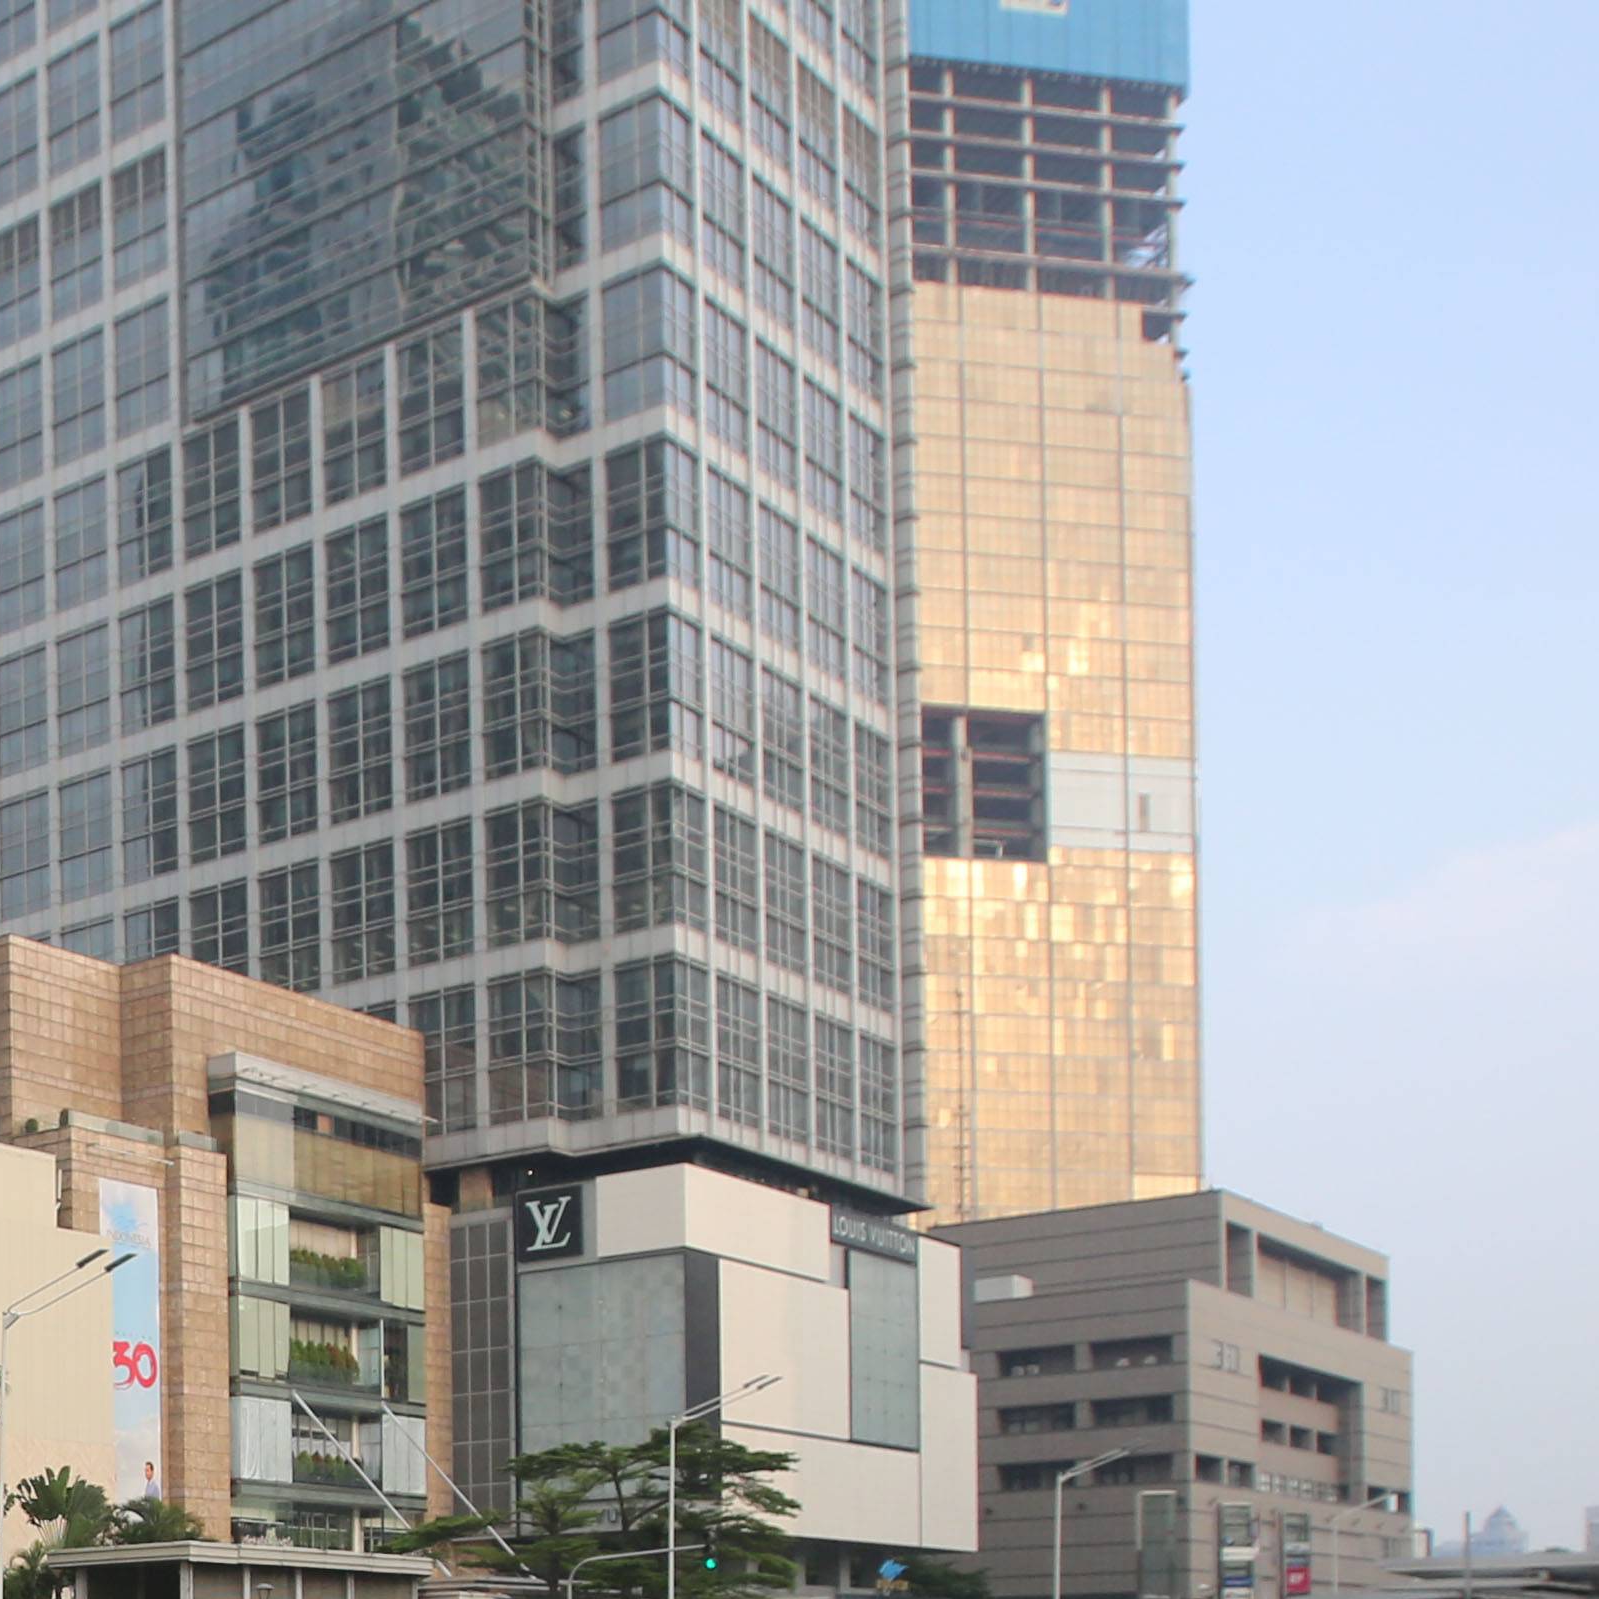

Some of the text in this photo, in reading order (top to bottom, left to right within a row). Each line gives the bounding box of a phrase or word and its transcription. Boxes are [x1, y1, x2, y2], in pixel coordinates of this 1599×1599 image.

[525, 1195, 572, 1252] LV
[833, 1214, 915, 1255] LOUIS VUITTON
[113, 1341, 158, 1390] 30
